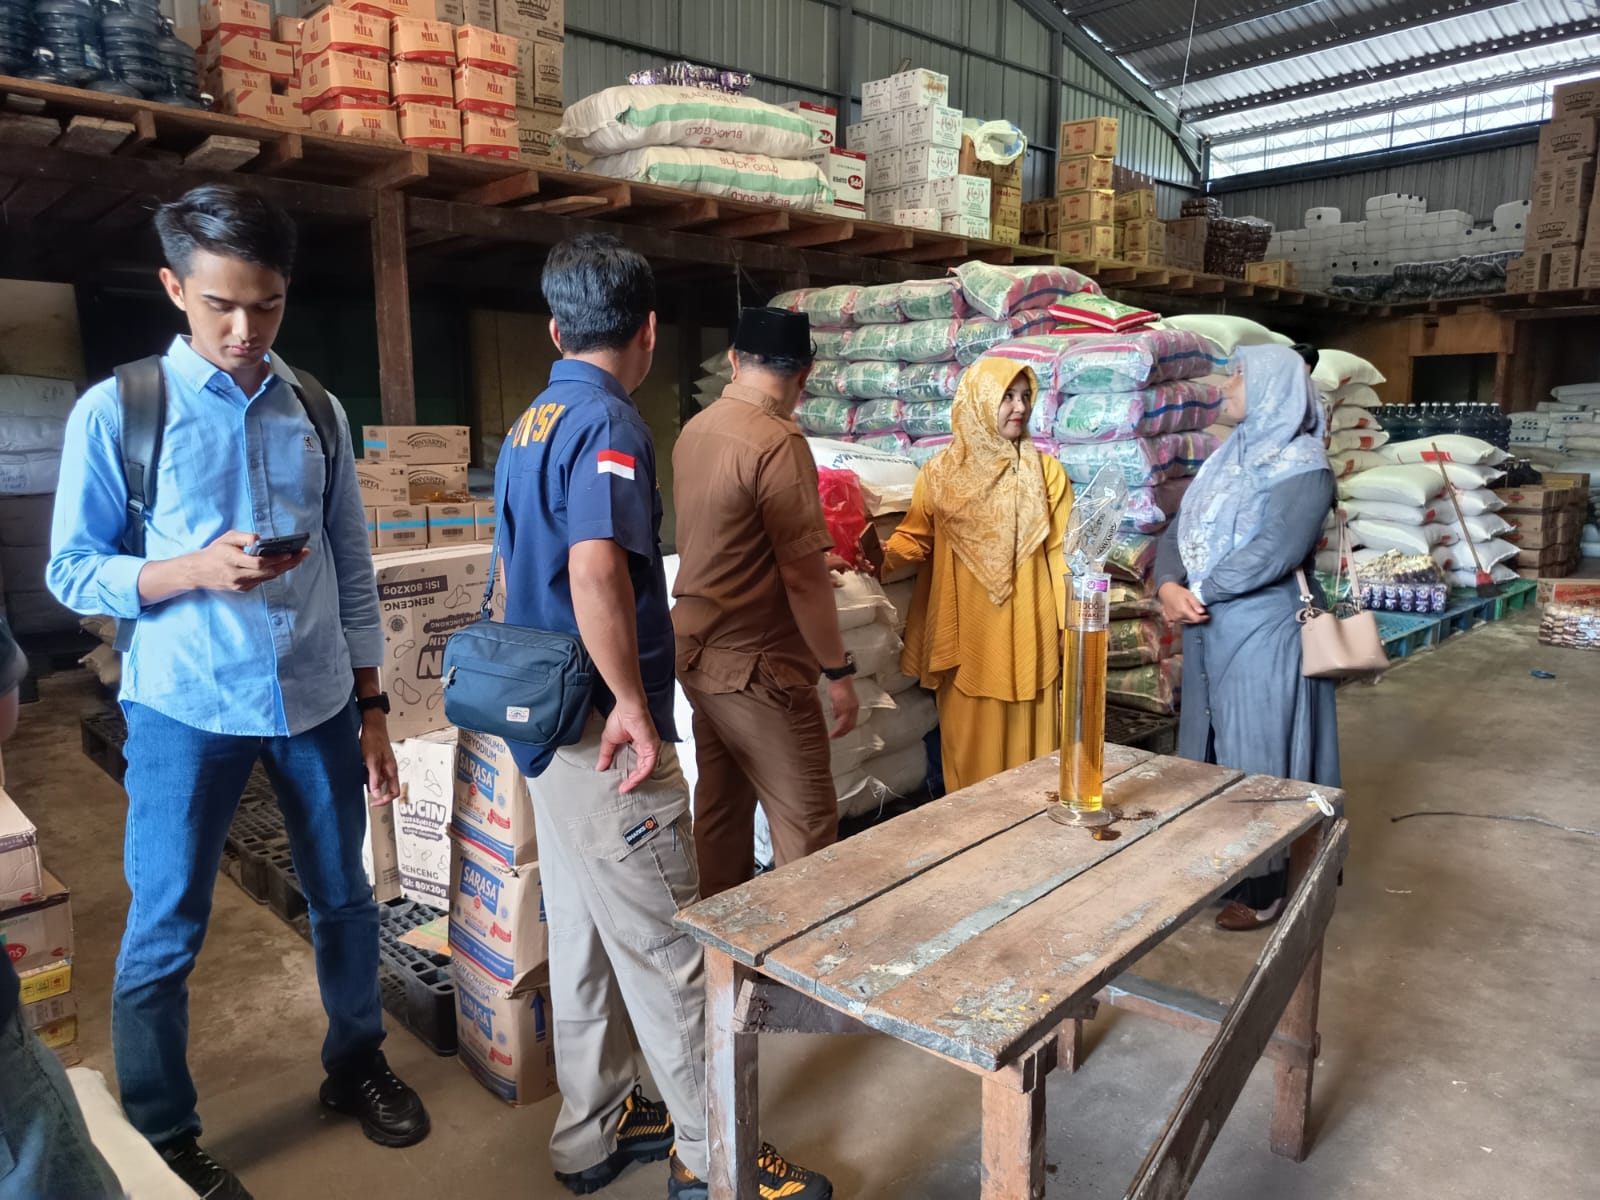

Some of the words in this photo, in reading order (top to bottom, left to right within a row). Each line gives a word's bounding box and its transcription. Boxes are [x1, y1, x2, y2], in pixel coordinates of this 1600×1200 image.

[353, 23, 374, 38] MILA
[421, 31, 439, 43] MILA
[249, 49, 267, 61] MILA
[489, 43, 506, 56] MILA
[353, 68, 373, 81] MILA
[420, 75, 439, 87] MILA
[486, 81, 503, 96] MILA
[266, 105, 284, 116] MILA
[361, 117, 382, 129] MILA
[428, 118, 447, 130] MILA
[489, 126, 506, 138] MILA
[685, 126, 712, 136] GOLD
[713, 129, 743, 139] BLACK
[519, 128, 552, 147] BUCIN
[730, 191, 758, 202] GOLD
[383, 582, 423, 595] 80X20g
[425, 579, 440, 588] ISI:
[384, 596, 435, 611] RENCENG
[460, 752, 493, 788] SARASA
[401, 863, 439, 880] RENCENG
[415, 881, 447, 897] 80X20g
[463, 865, 496, 901] SARASA
